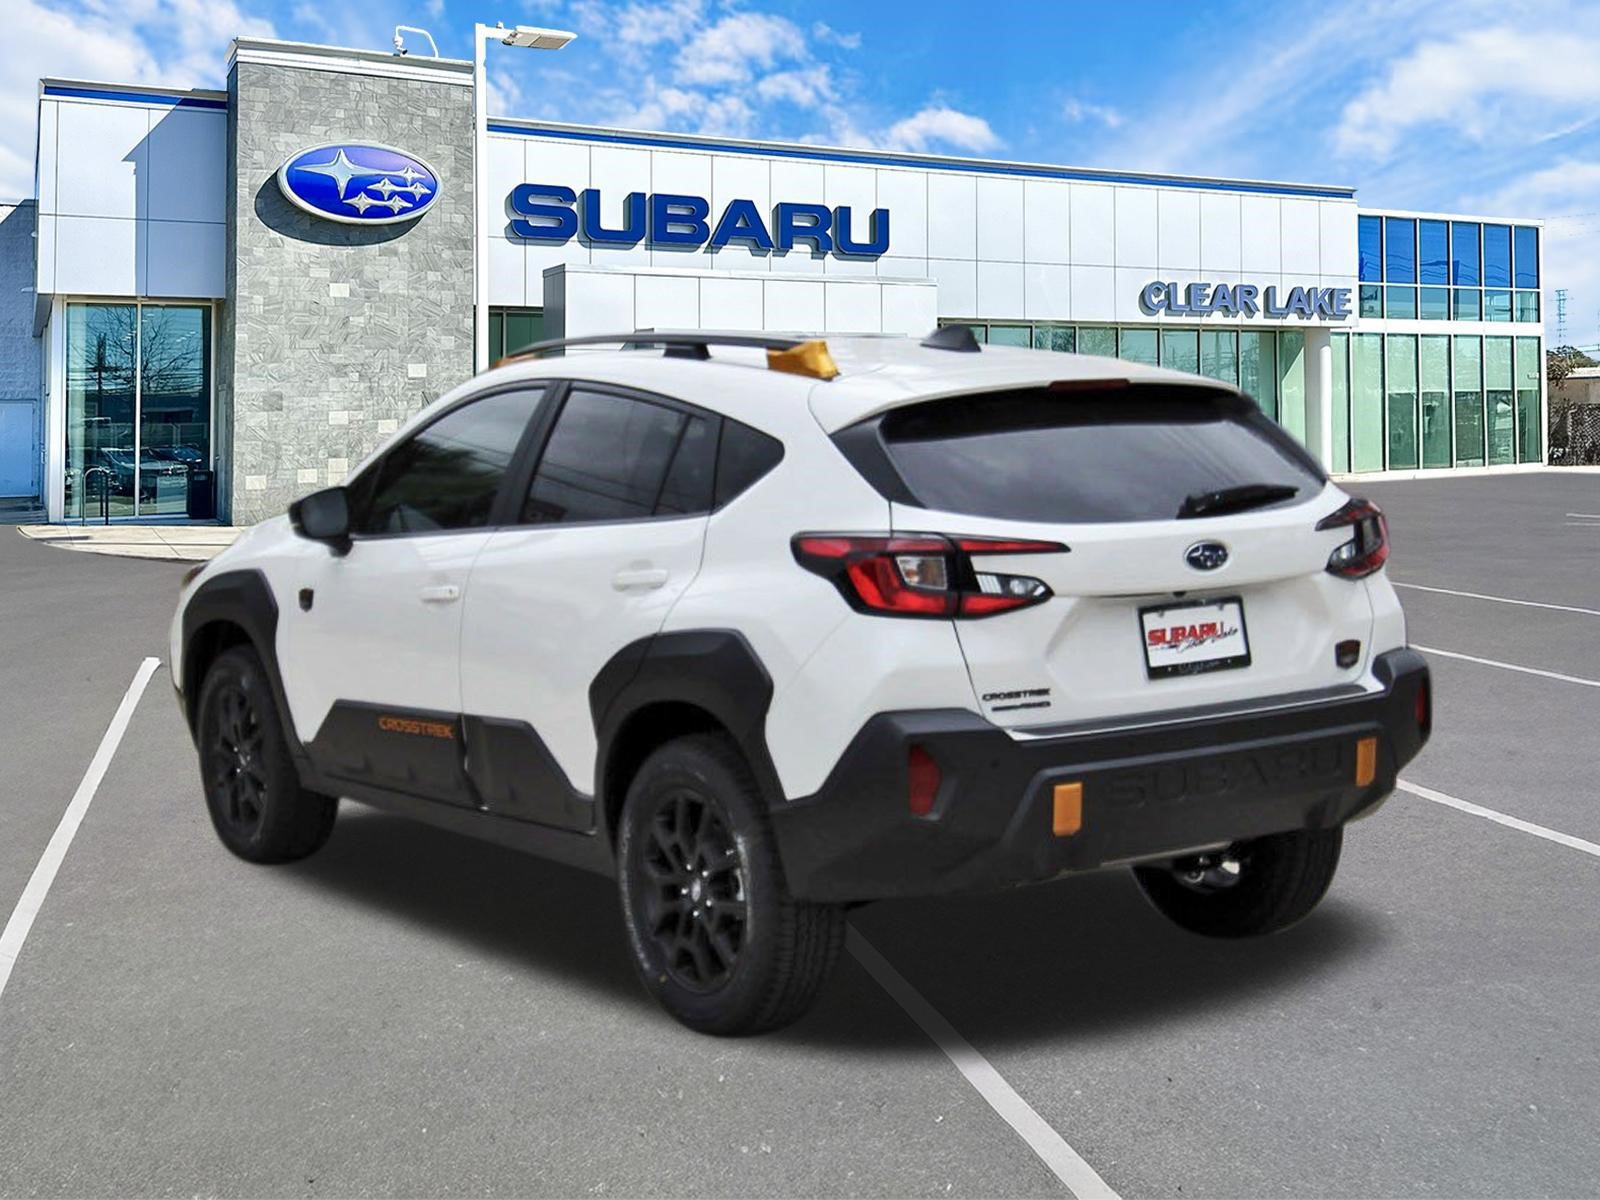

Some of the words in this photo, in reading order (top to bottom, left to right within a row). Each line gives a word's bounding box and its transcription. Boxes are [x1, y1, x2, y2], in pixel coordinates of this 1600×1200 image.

[506, 183, 890, 258] SUBARU
[1140, 281, 1260, 317] CLEAR
[1264, 285, 1353, 319] LAKE
[1148, 621, 1224, 646] SUBARU
[378, 716, 455, 739] CROSSTREK
[1104, 742, 1343, 807] SUBARU
